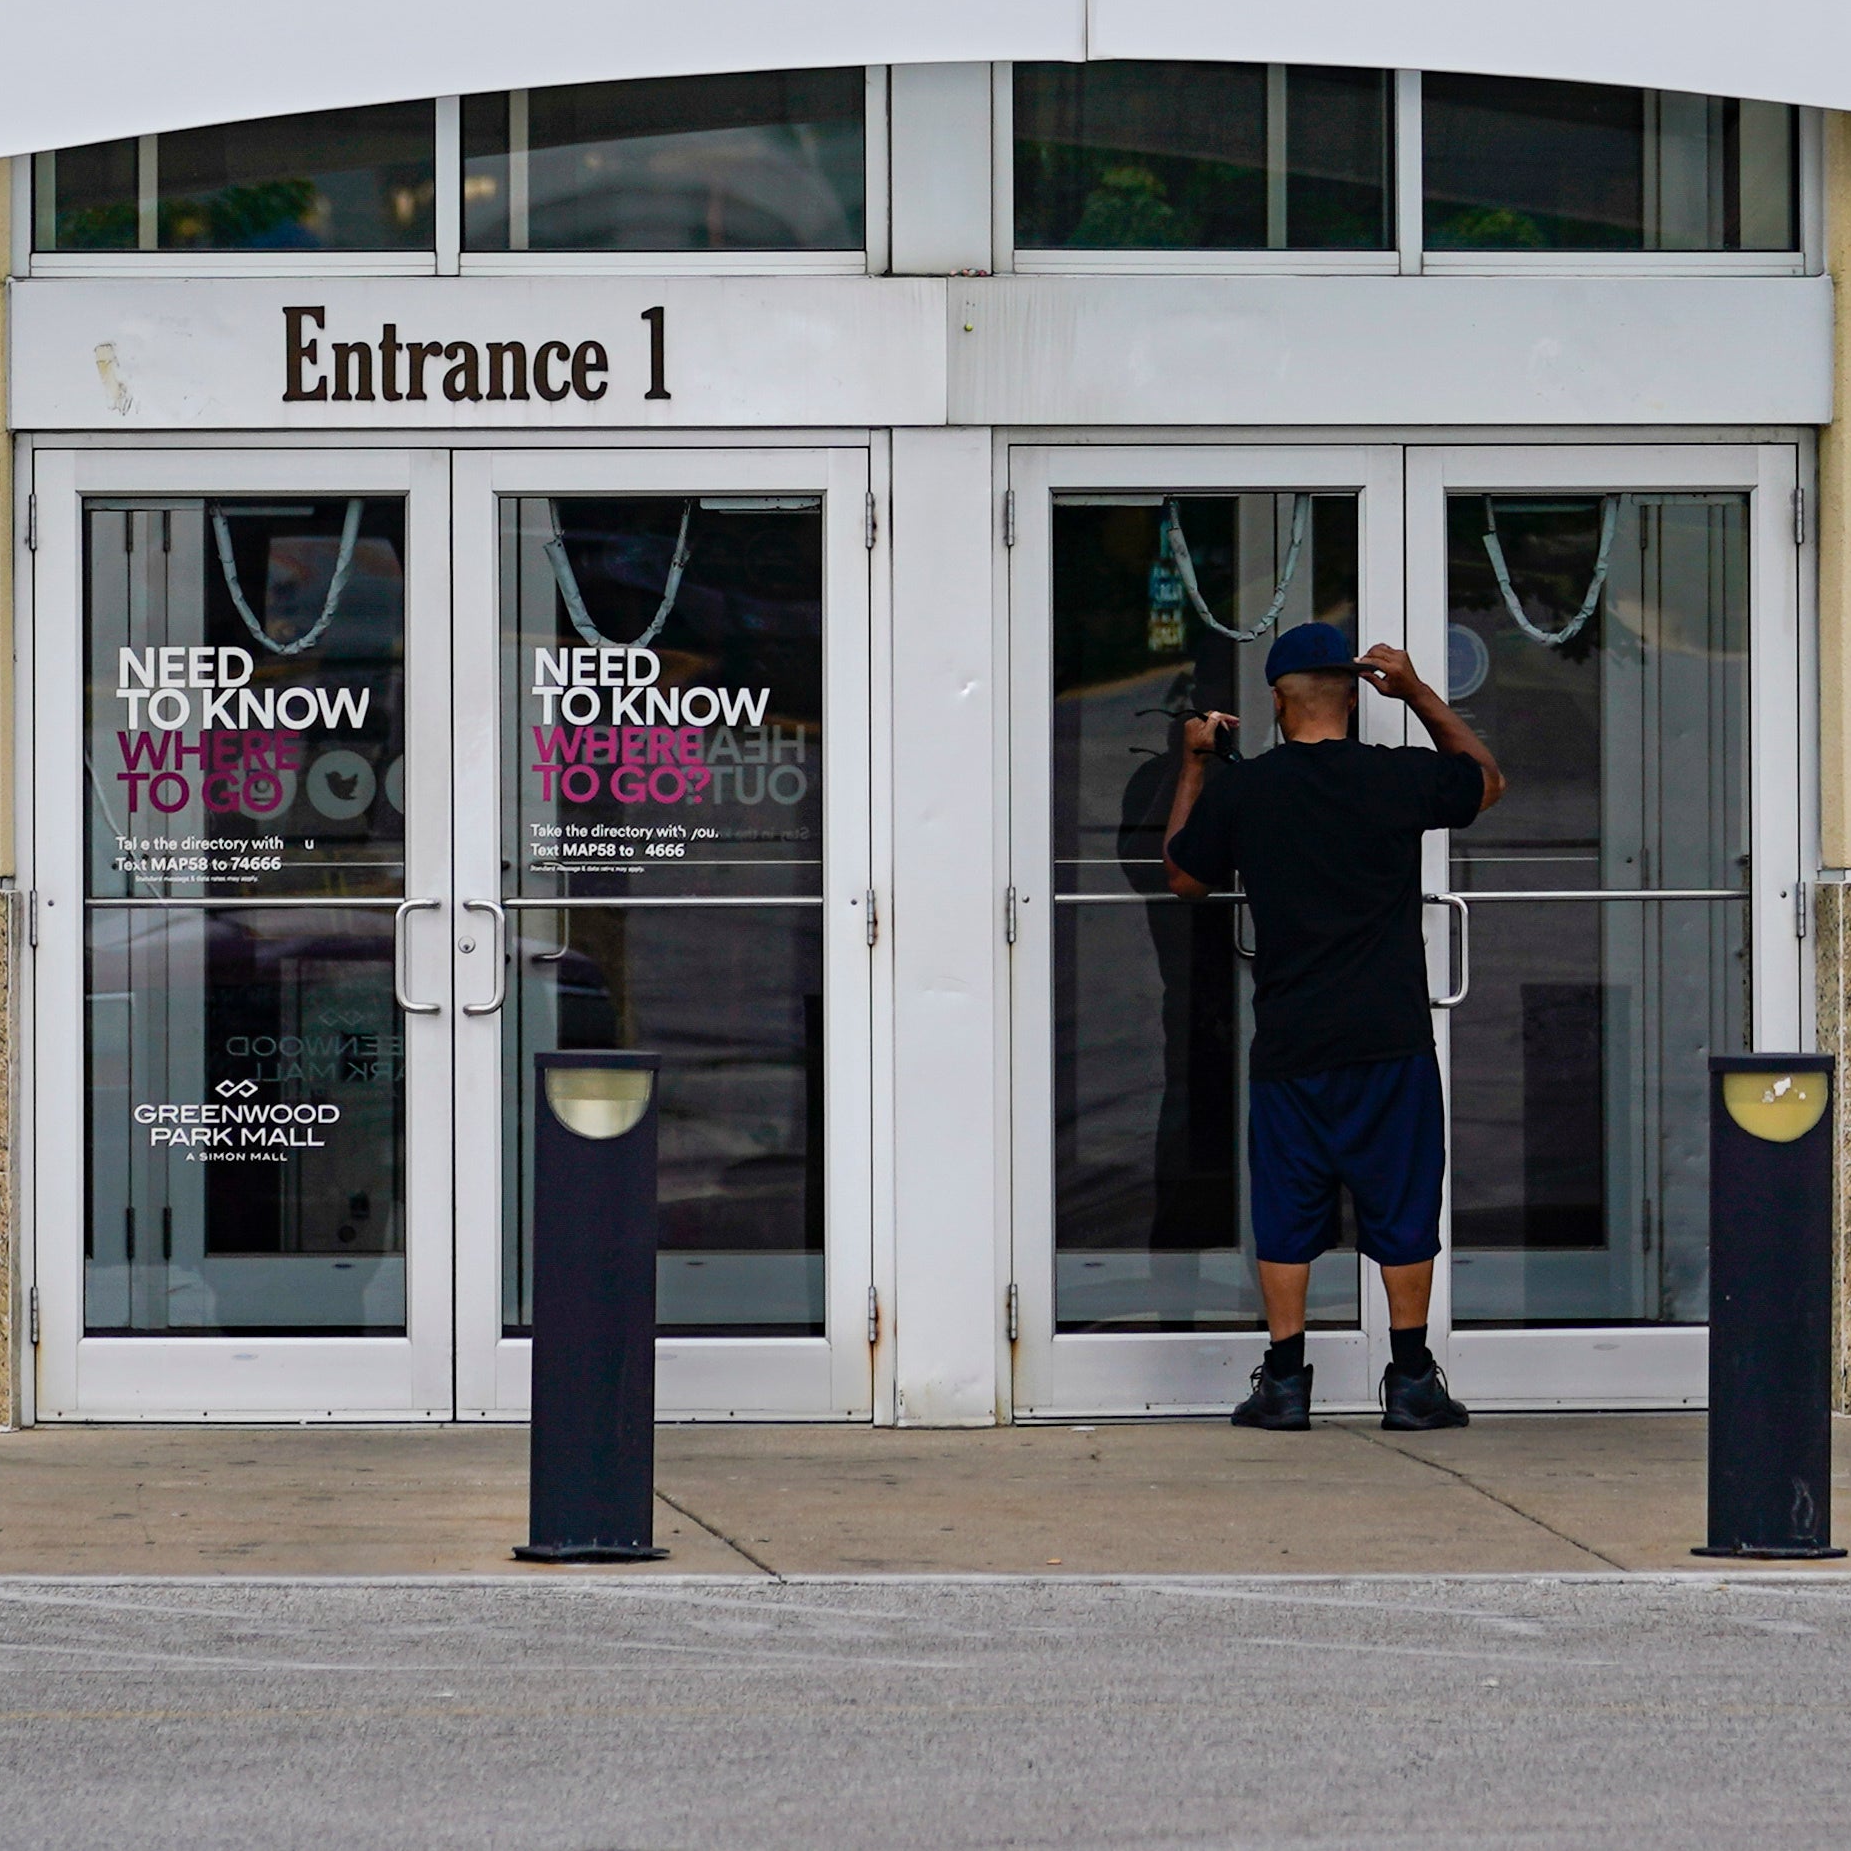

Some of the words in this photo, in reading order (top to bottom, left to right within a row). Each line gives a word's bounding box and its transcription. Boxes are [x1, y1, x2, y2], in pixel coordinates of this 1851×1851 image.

[282, 305, 609, 402] Entrance
[641, 305, 672, 400] 1
[119, 646, 254, 688] NEED
[534, 647, 661, 687] NEED
[116, 688, 190, 730] TO
[203, 687, 370, 730] KNOW
[532, 687, 601, 726] TO
[612, 687, 770, 727] KNOW
[117, 730, 300, 771] WHERE
[532, 726, 705, 765] WHERE
[117, 772, 190, 814] TO
[202, 772, 283, 814] GO
[532, 765, 600, 803] TO
[610, 765, 712, 805] GO?
[152, 837, 183, 850] the
[184, 836, 249, 854] directory
[252, 836, 284, 850] with
[530, 824, 562, 838] Take
[565, 824, 588, 838] the
[591, 824, 652, 841] directory
[530, 843, 559, 857] Text
[563, 843, 616, 857] MAP58
[619, 844, 634, 857] to
[116, 857, 148, 871] Text
[151, 857, 208, 871] MAP58
[212, 858, 227, 871] to
[230, 857, 282, 871] 74666
[134, 1104, 340, 1124] GREENWOOD
[150, 1127, 233, 1147] PARK
[241, 1128, 325, 1147] MALL
[185, 1152, 195, 1162] A
[199, 1152, 245, 1162] SIMON
[250, 1152, 288, 1162] MALL
